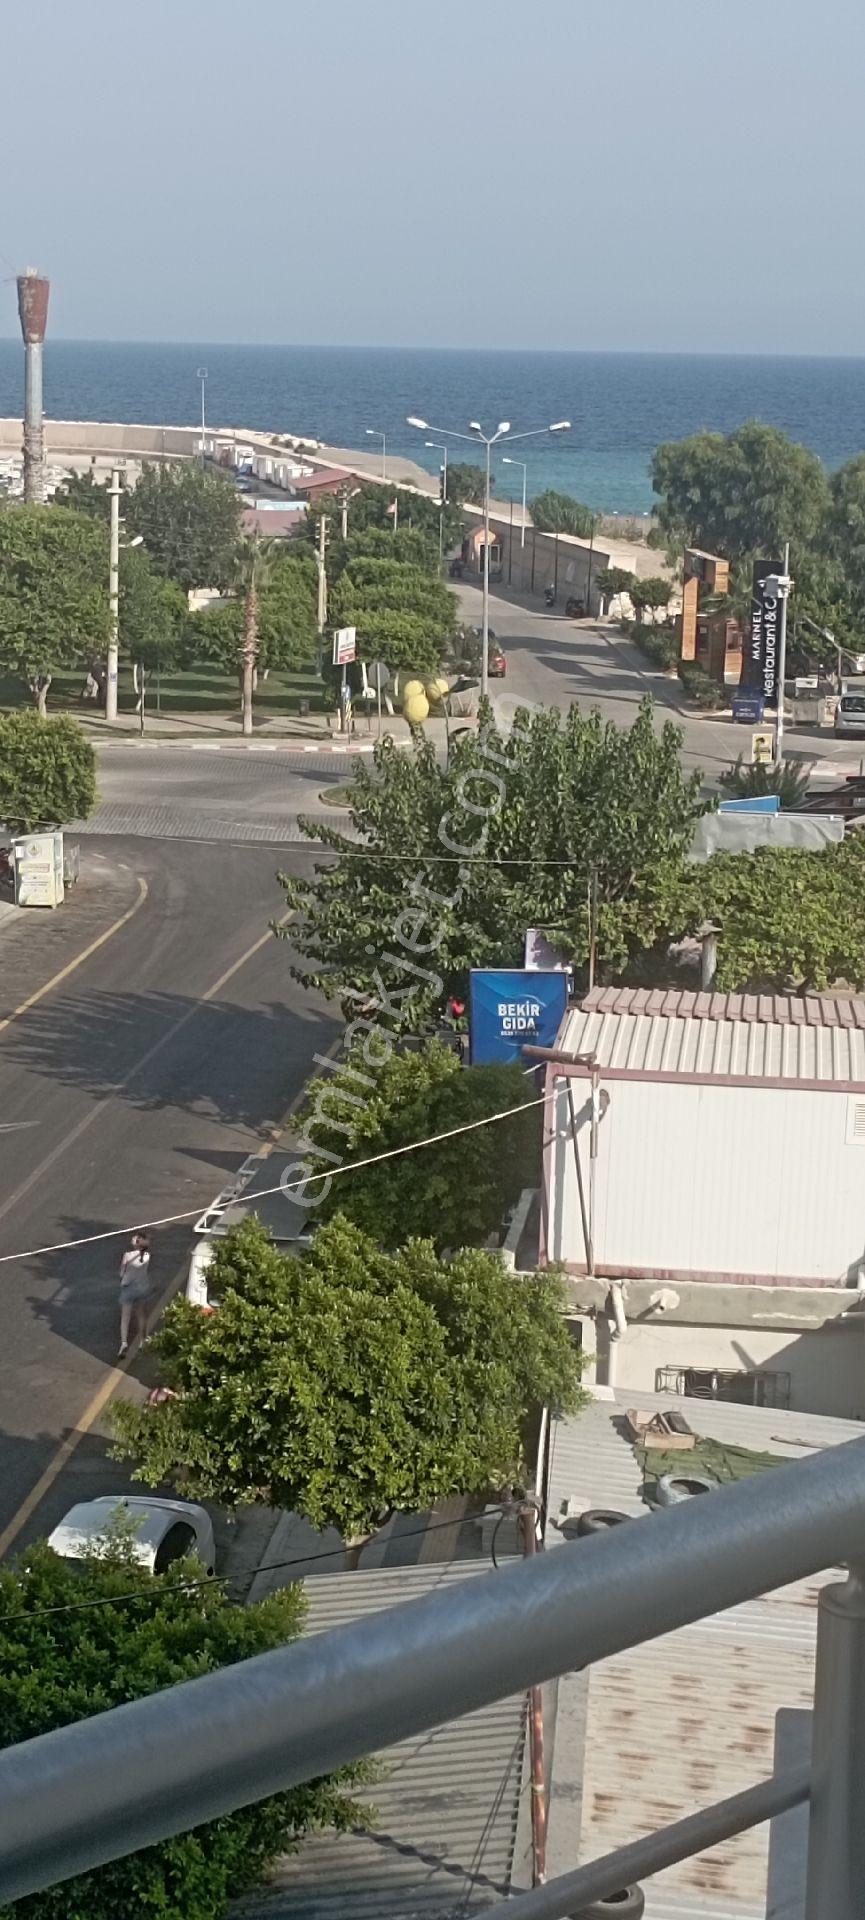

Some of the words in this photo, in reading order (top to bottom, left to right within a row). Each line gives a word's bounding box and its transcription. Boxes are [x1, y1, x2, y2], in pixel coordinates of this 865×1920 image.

[764, 610, 777, 622] &
[752, 609, 761, 660] MARNEL
[498, 1000, 540, 1017] BEKİR
[502, 1017, 536, 1030] GIDA
